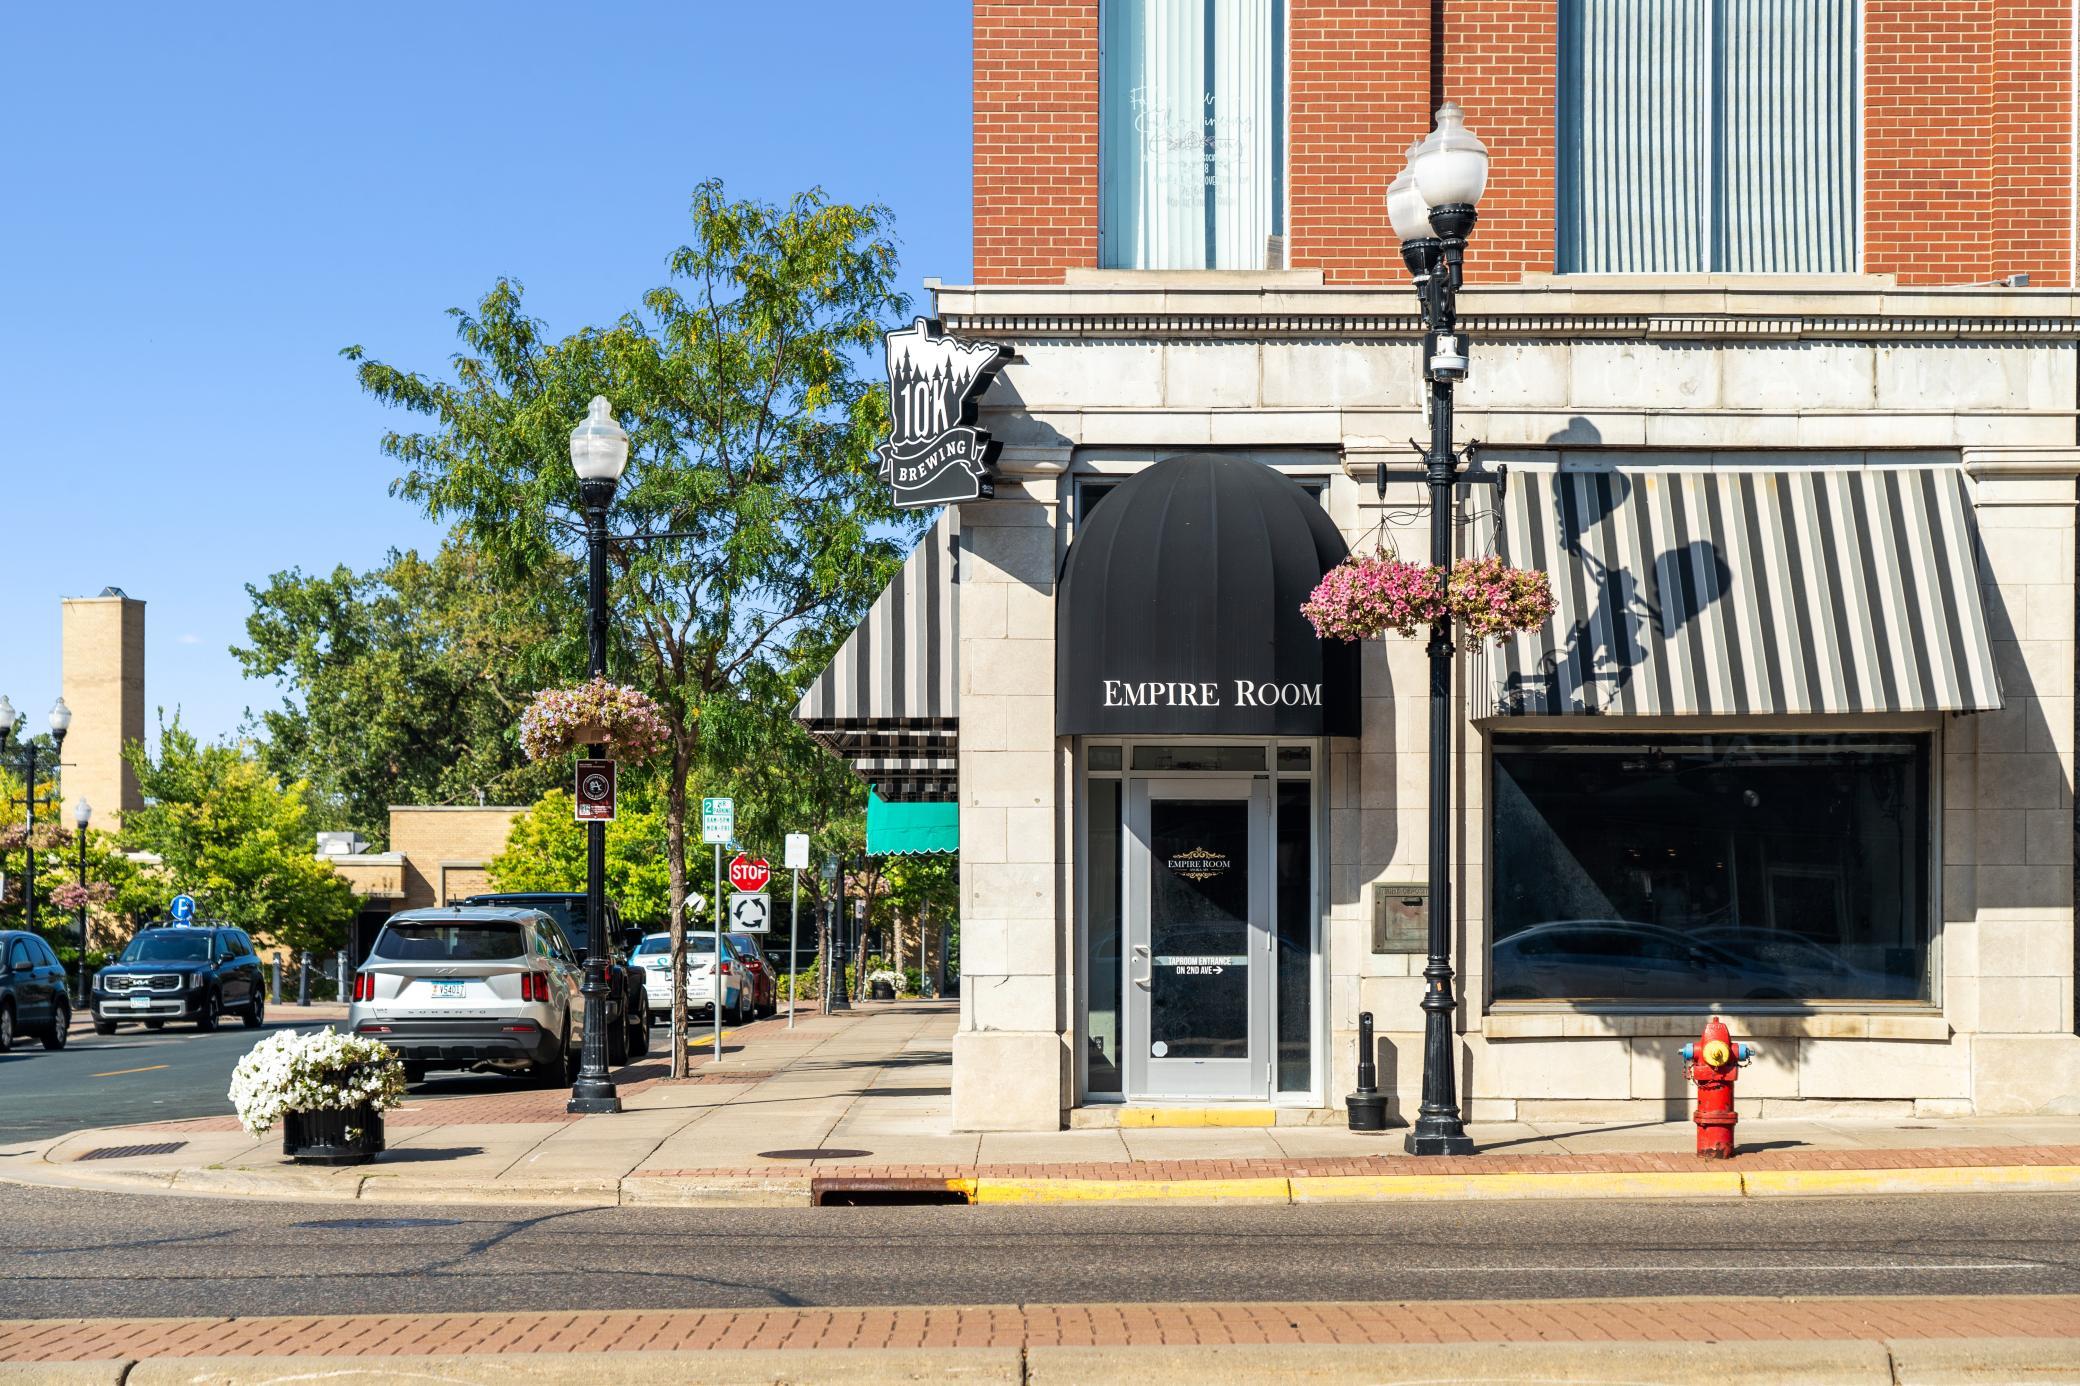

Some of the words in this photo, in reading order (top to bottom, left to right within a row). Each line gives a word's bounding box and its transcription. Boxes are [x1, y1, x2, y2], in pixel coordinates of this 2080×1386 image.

[901, 379, 949, 438] 10K
[899, 440, 966, 481] BREWING
[1103, 680, 1220, 706] EMPIRE
[1234, 680, 1323, 706] ROOM
[705, 802, 712, 813] 2
[1168, 860, 1201, 868] EMPIRE
[1203, 860, 1231, 868] ROOM
[732, 865, 767, 880] STOP
[1168, 956, 1198, 966] TAPROOM
[1198, 956, 1232, 966] ENTRANCE
[1176, 966, 1186, 975] ON
[1186, 966, 1200, 975] 2ND
[1200, 966, 1213, 975] AVE
